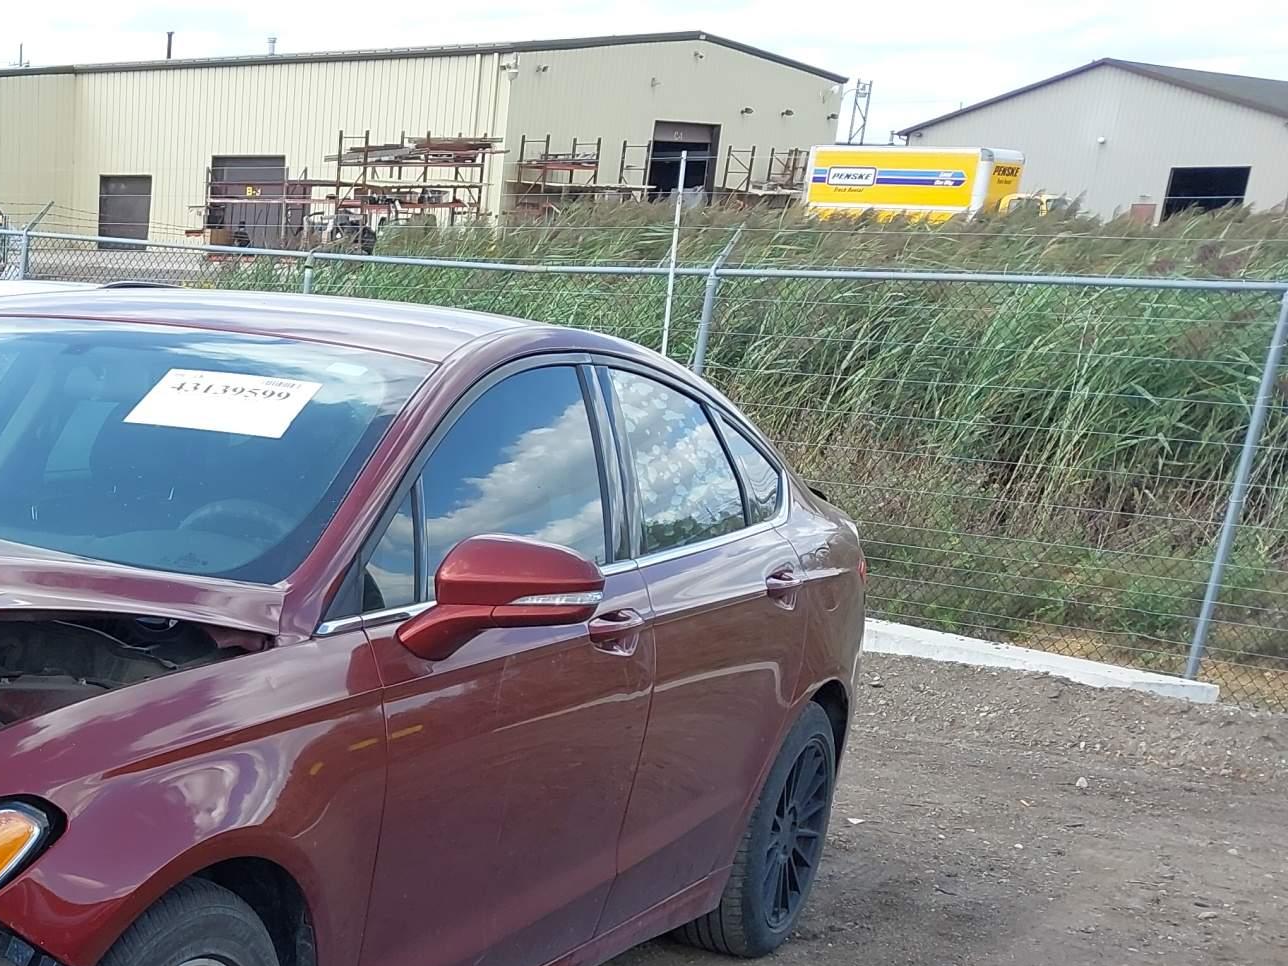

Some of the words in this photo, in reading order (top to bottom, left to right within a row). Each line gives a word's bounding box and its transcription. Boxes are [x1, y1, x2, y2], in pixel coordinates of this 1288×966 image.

[831, 172, 873, 181] PENSKE
[992, 165, 1020, 177] PENSKE
[170, 381, 292, 402] 43139599
